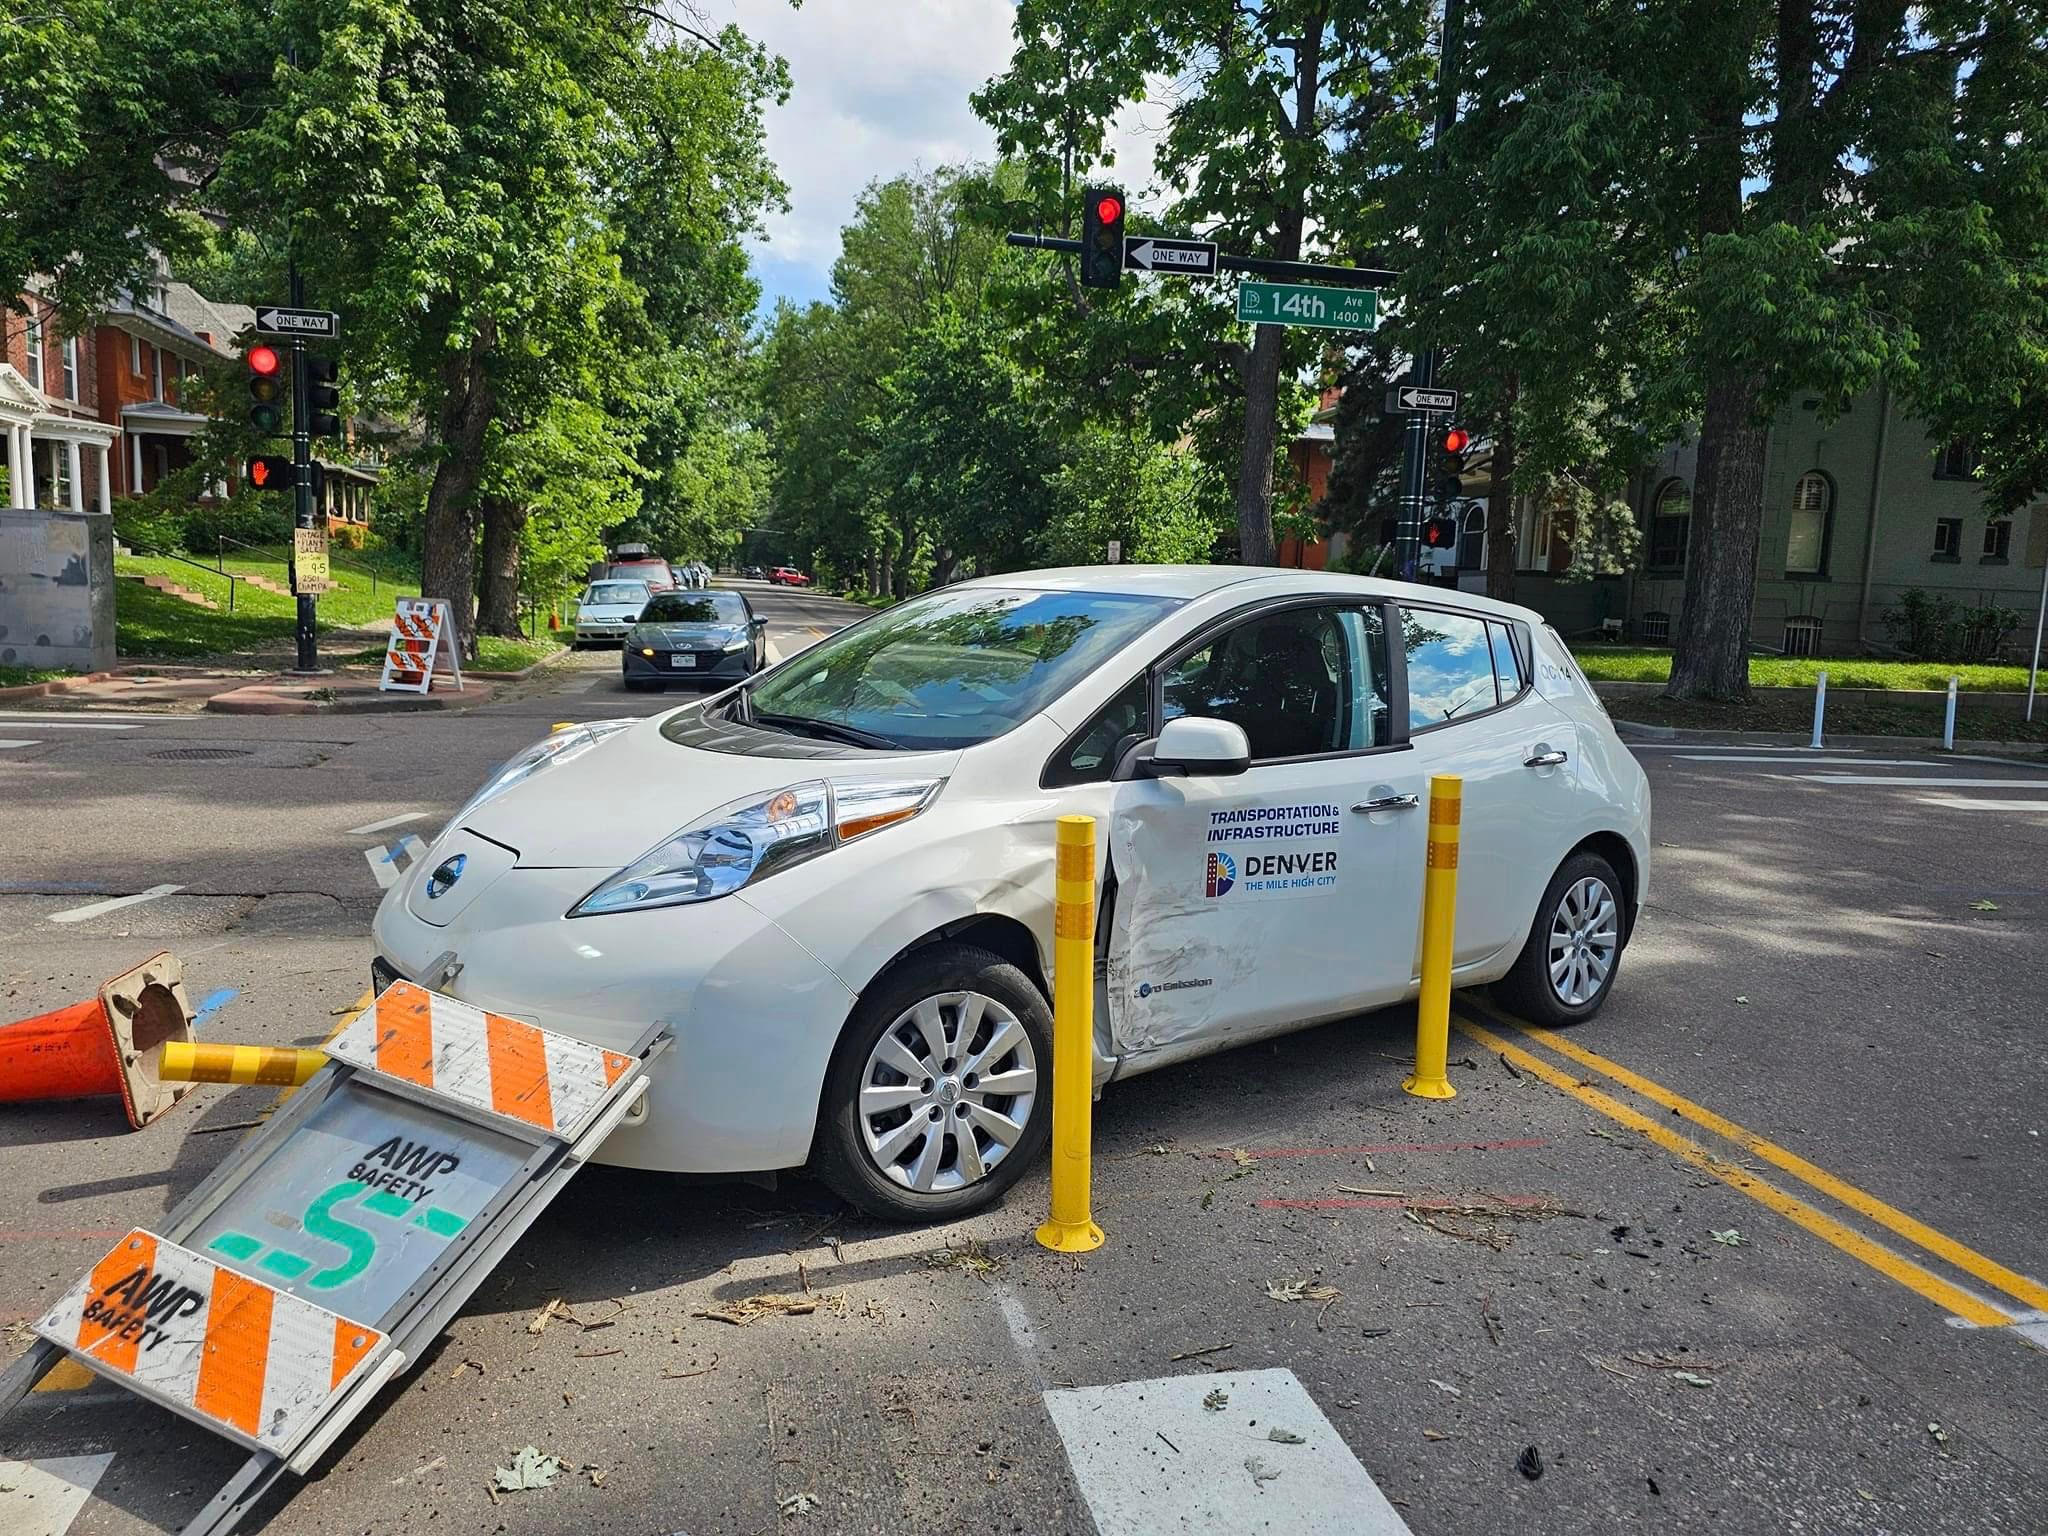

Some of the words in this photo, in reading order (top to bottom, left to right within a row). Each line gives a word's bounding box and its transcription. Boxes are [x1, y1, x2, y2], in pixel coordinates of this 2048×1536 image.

[1151, 250, 1175, 262] ONE
[1179, 251, 1202, 264] WAY
[1272, 291, 1325, 319] 14th
[1344, 295, 1363, 307] Ave
[276, 315, 297, 327] ONE
[301, 317, 325, 328] WAY
[1333, 310, 1359, 324] 1400
[1364, 313, 1372, 324] N
[1416, 395, 1432, 404] ONE
[1434, 396, 1450, 404] WAY
[296, 530, 325, 539] VINTAGE
[302, 574, 320, 582] 2501
[297, 582, 328, 592] CHAMPA
[1210, 804, 1331, 825] TRANSPORTATION
[1207, 821, 1339, 841] INFRASTRUCTURE
[1245, 851, 1337, 877] DENVER
[1244, 881, 1263, 891] THE
[1266, 880, 1288, 890] MILE
[1291, 877, 1315, 888] HIGH
[1317, 875, 1337, 886] CITY
[1163, 978, 1213, 992] Emission
[363, 1136, 461, 1181] AWP
[347, 1162, 434, 1203] SAFETY
[104, 1267, 205, 1326] AWP
[82, 1299, 170, 1352] SAFETY
